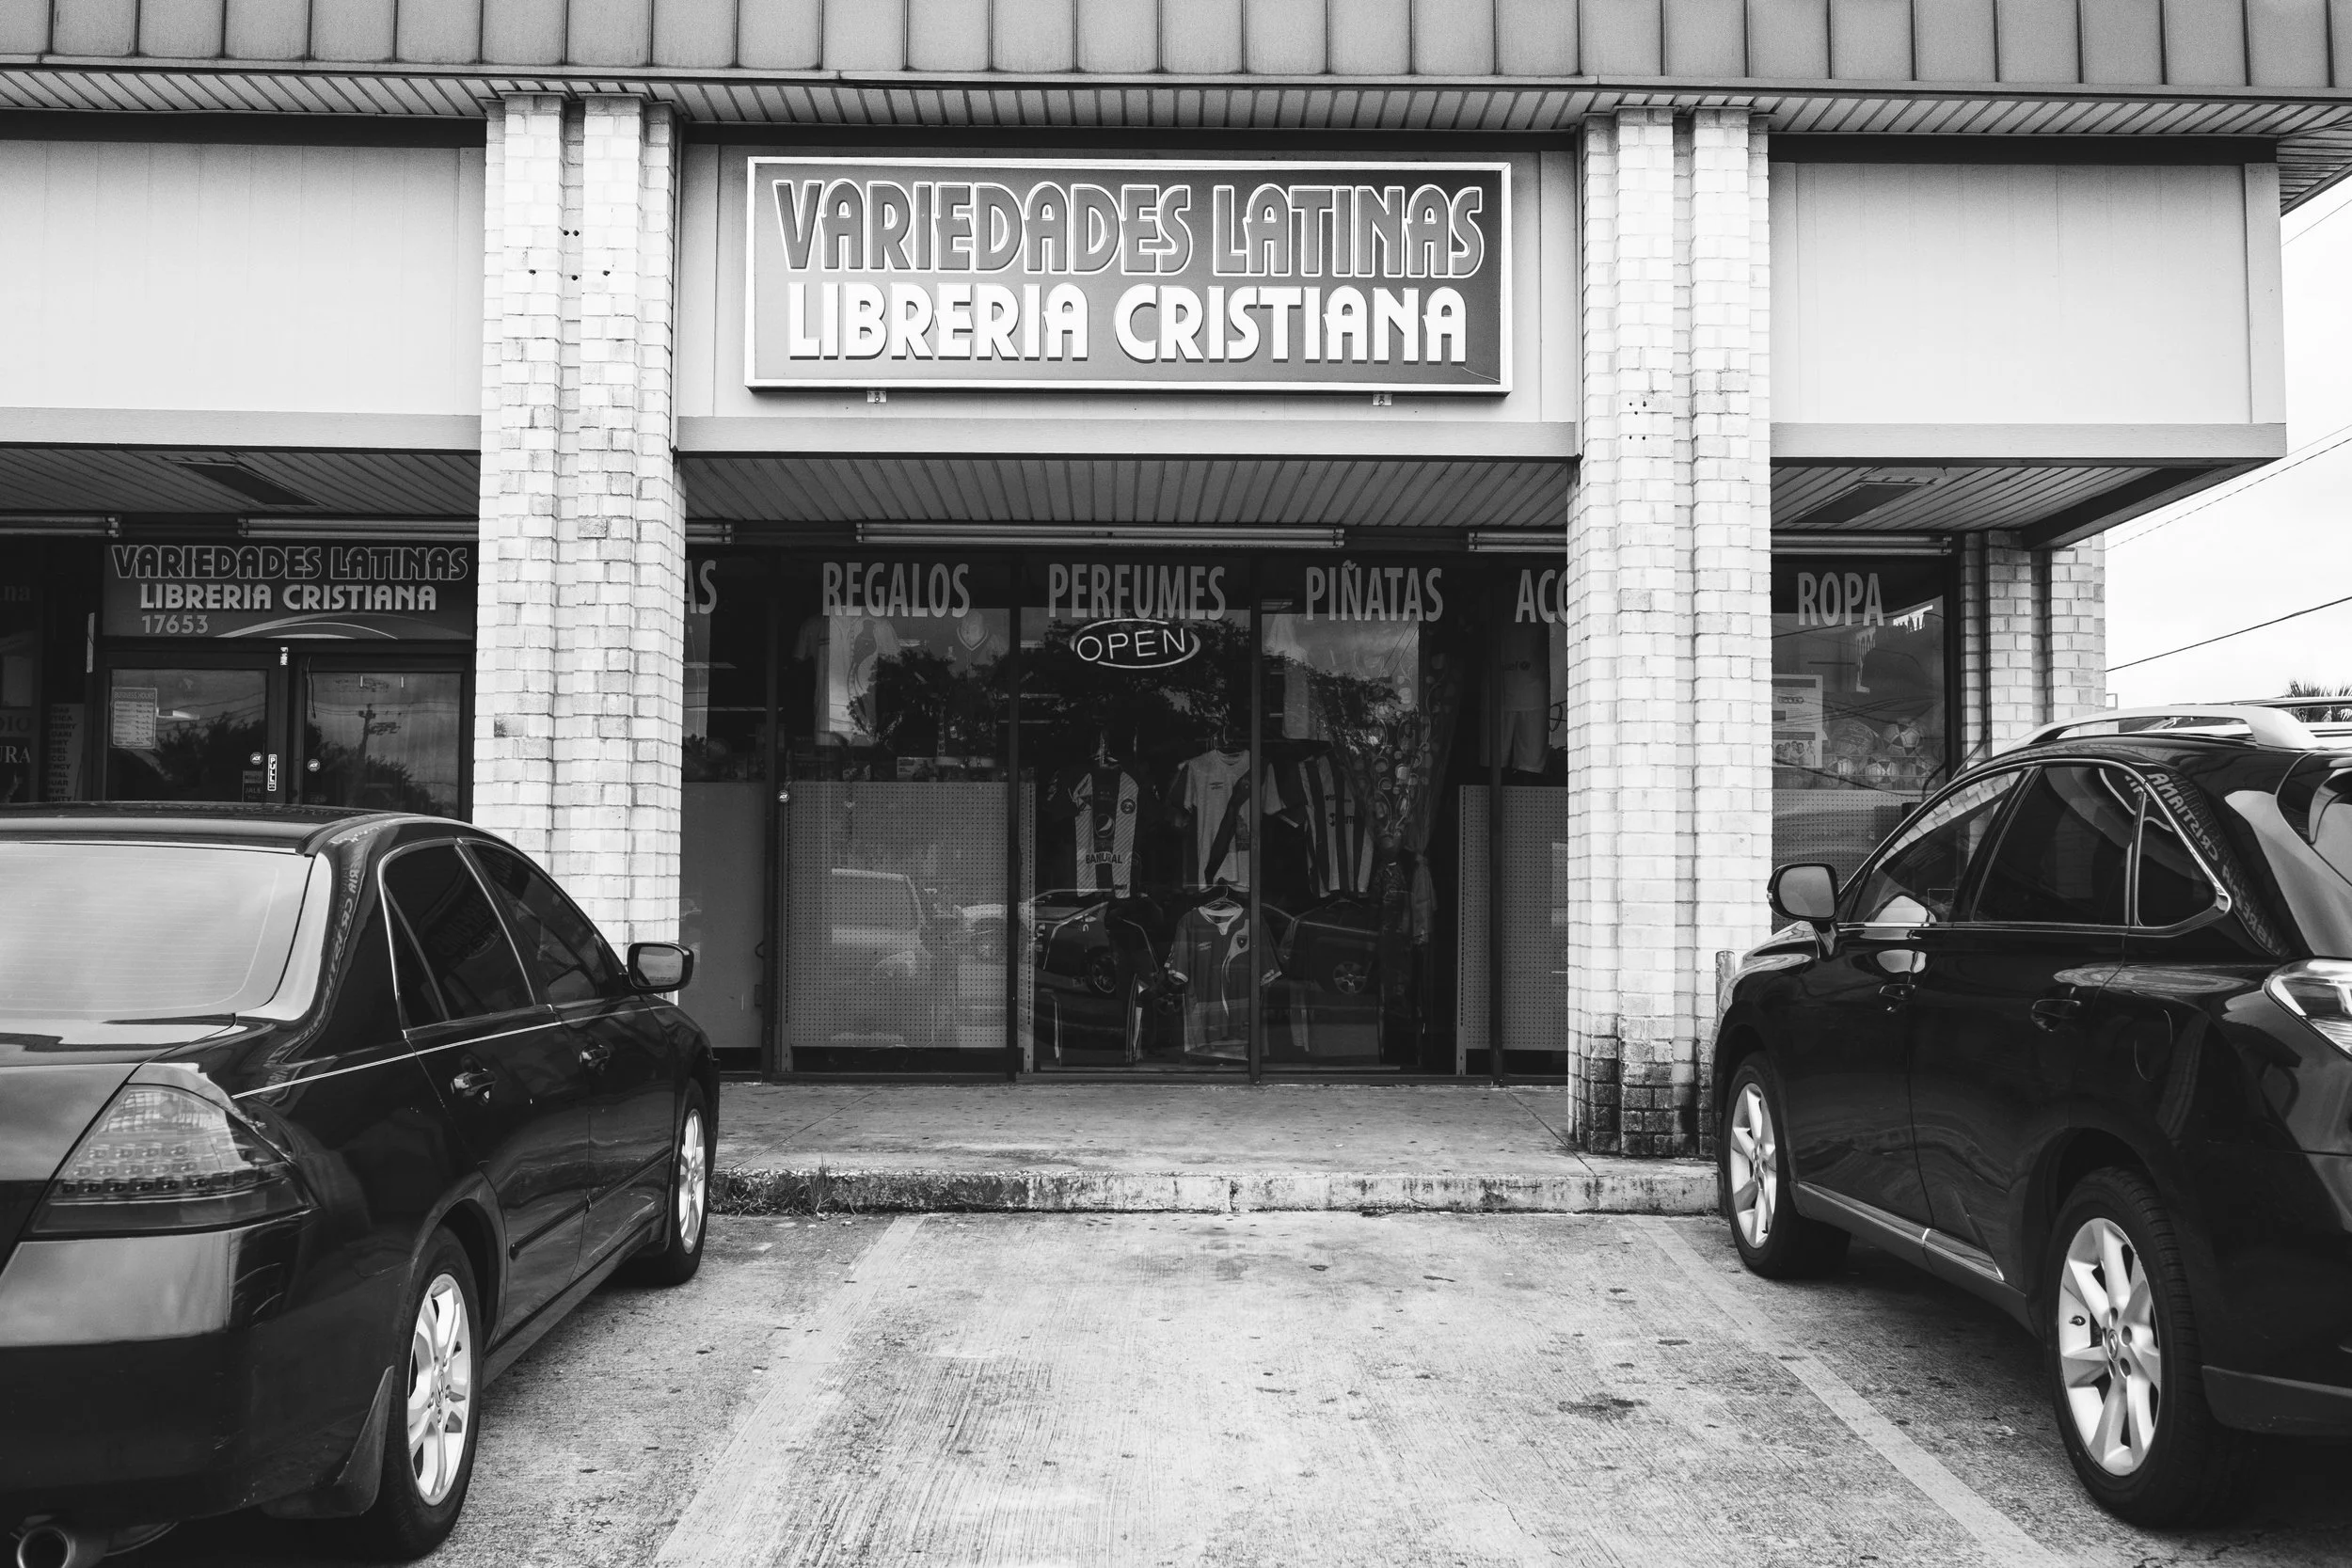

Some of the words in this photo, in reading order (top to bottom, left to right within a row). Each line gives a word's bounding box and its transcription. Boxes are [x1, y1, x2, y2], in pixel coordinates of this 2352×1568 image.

[771, 179, 1193, 277] VARIEDADES
[1212, 183, 1485, 279] LATINAS
[787, 281, 1089, 362] LIBRERIA
[1113, 284, 1467, 363] CRISTIANA
[110, 545, 321, 579] VARIEDADES
[329, 546, 469, 581] LATINAS
[822, 562, 970, 618] REGALOS
[140, 583, 272, 611] LIBRERIA
[282, 584, 437, 612] CRISTIANA
[1048, 563, 1227, 621] PERFUMES
[1306, 560, 1443, 623] PIÑATAS
[1798, 572, 1884, 627] ROPA
[141, 614, 210, 636] 17653
[1076, 626, 1186, 662] OPEN
